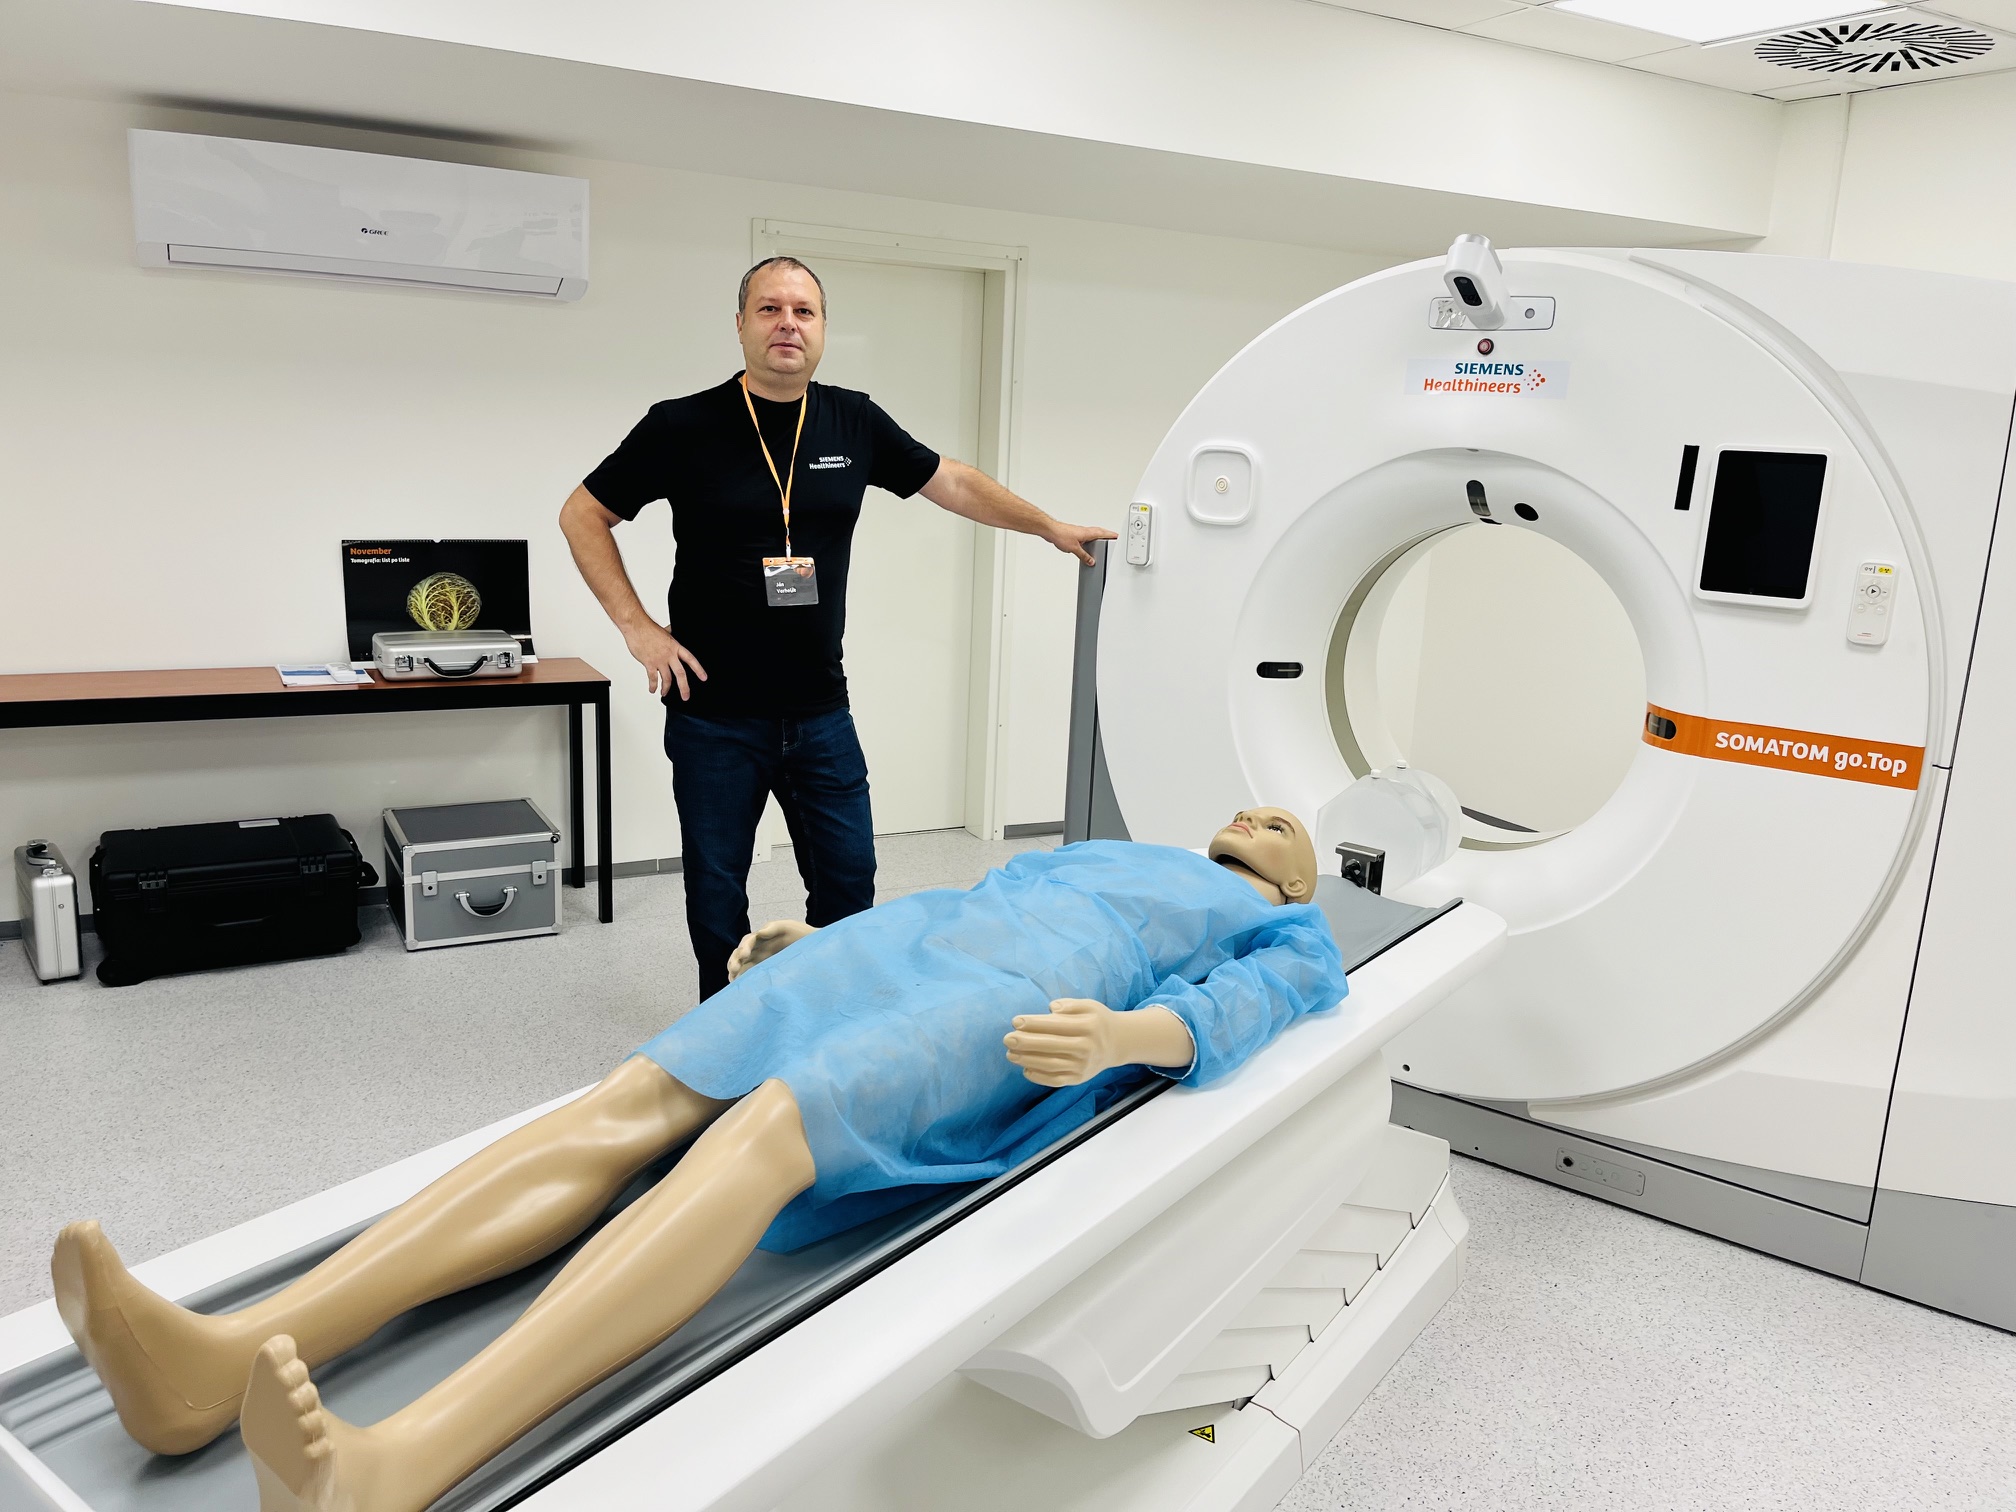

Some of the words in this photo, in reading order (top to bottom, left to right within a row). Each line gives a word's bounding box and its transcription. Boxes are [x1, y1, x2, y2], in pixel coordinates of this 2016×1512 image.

[1454, 362, 1524, 376] SIEMENS
[1423, 378, 1521, 394] Healthineers
[809, 462, 846, 470] Healthineers
[350, 547, 392, 555] November
[1715, 732, 1829, 763] SOMATOM
[1834, 751, 1908, 778] go.Top
